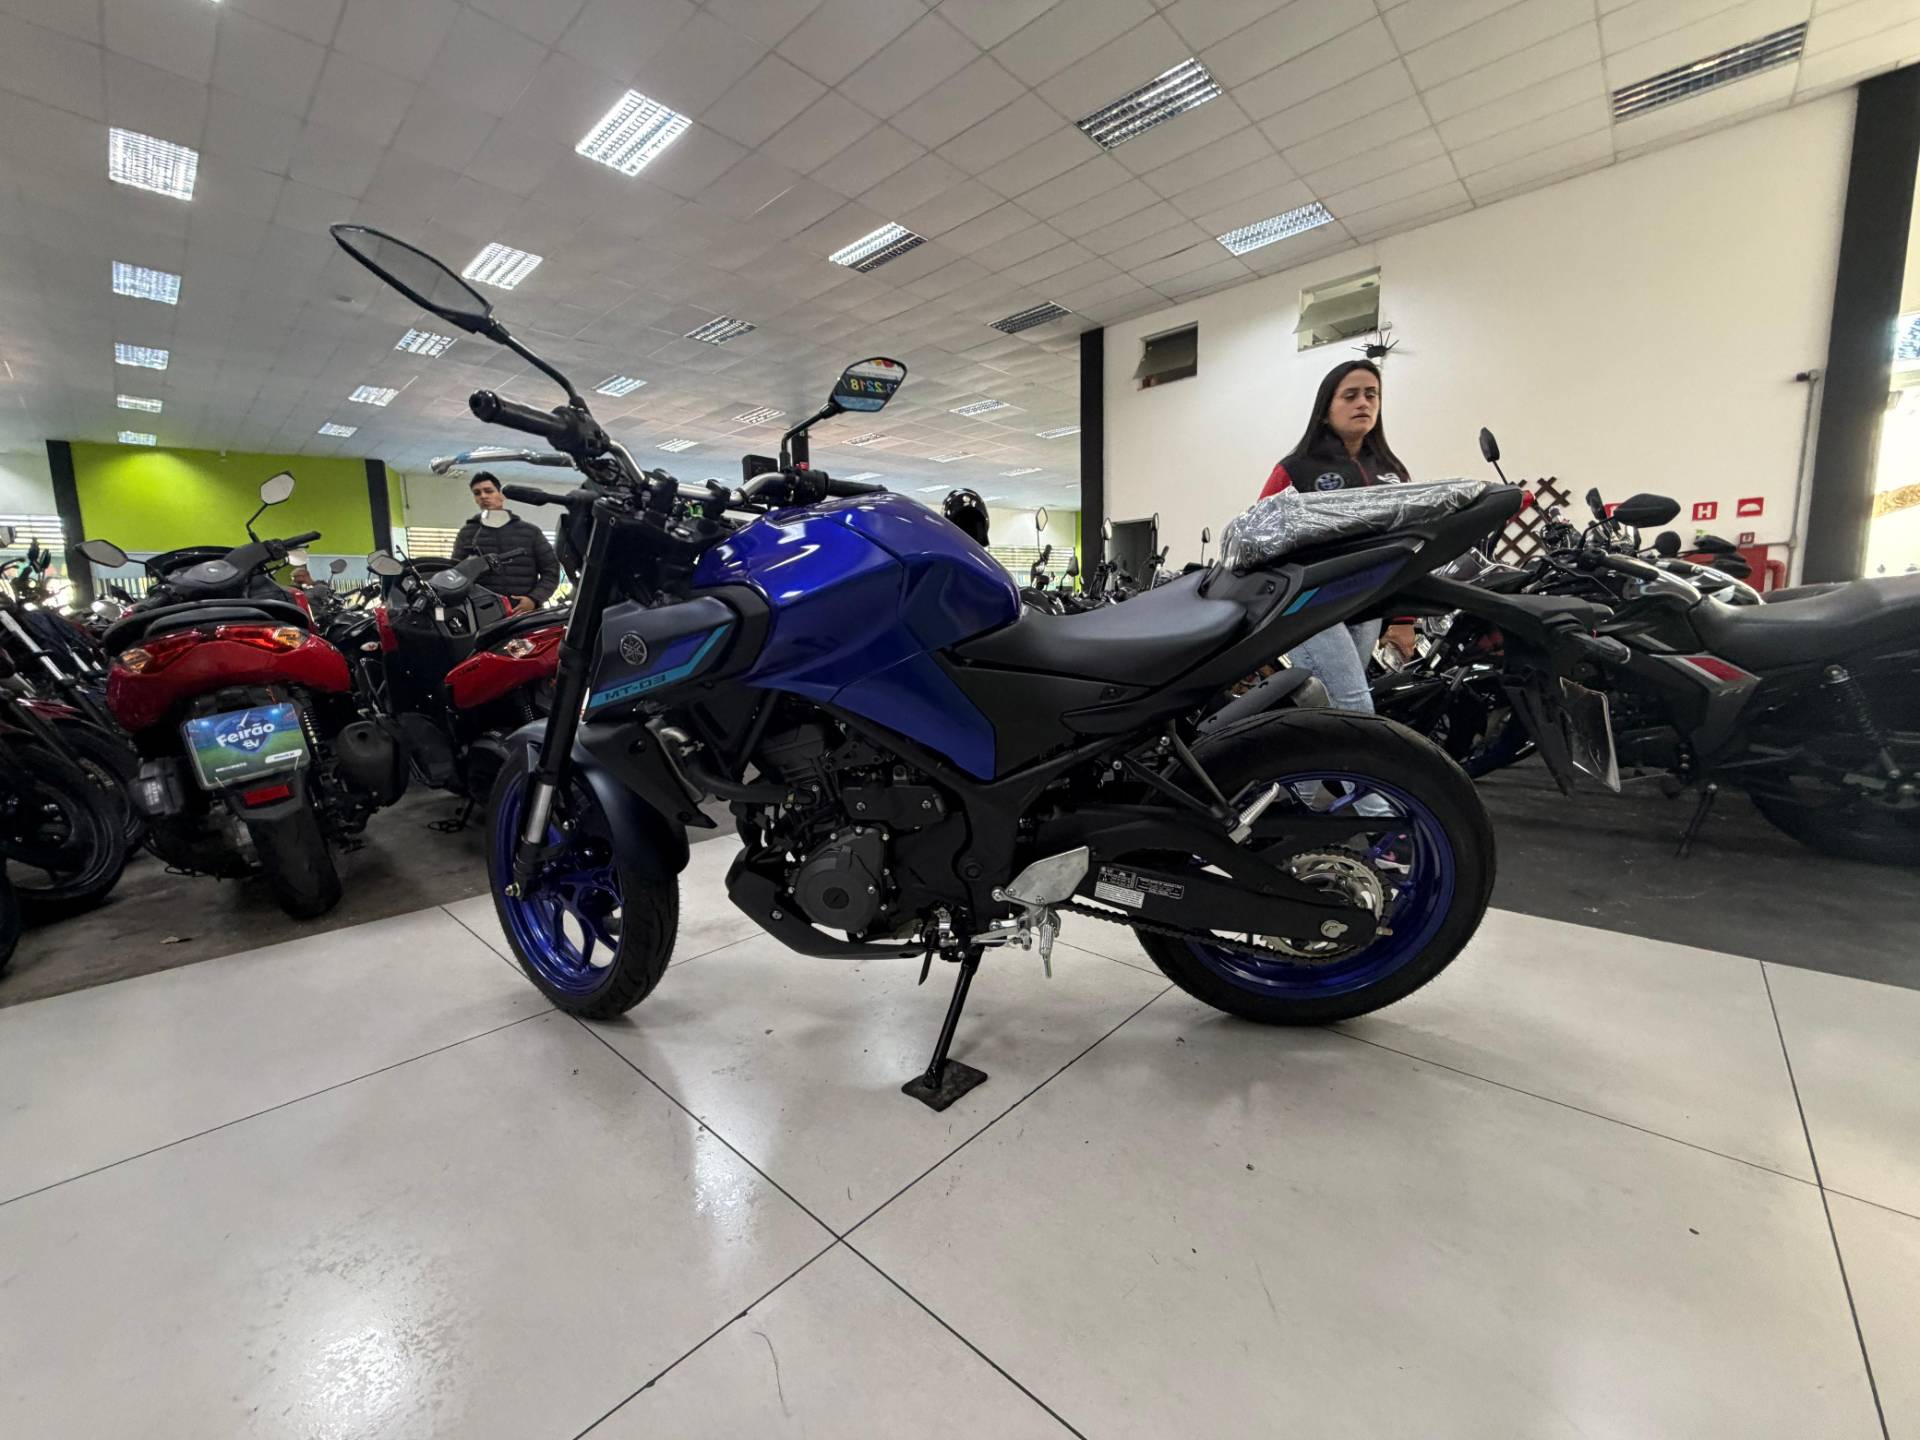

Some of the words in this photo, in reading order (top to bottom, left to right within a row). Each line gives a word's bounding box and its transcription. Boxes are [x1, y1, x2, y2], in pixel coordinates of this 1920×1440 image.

[1698, 505, 1713, 519] H
[605, 673, 667, 700] MT-03
[215, 722, 275, 748] Feirão
